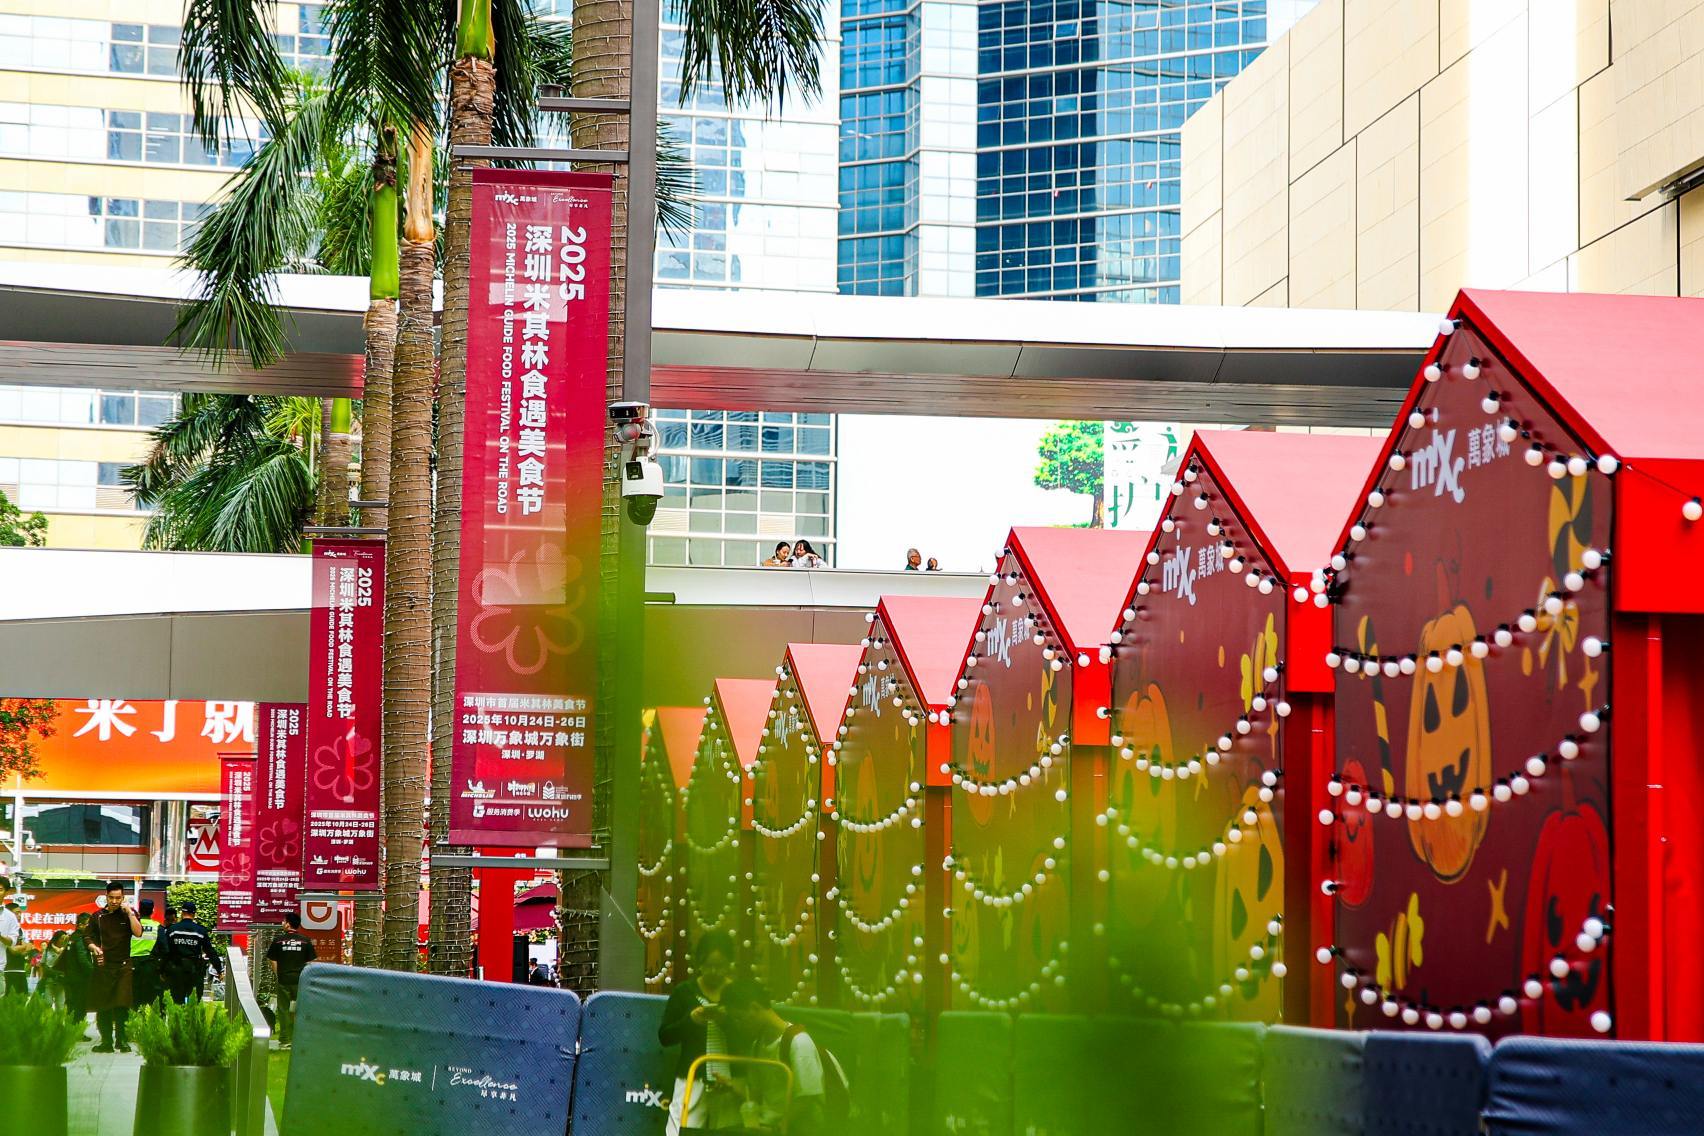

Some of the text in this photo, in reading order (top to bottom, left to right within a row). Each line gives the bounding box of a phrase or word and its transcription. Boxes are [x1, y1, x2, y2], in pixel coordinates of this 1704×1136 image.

[559, 226, 587, 300] 2025
[497, 223, 516, 514] 2025 MICHELIN GUIDE FOOD FESTIVAL ON THE ROAD
[516, 225, 553, 515] 深圳米其林食遇美食节
[358, 567, 373, 607] 2025
[337, 567, 355, 719] 深圳米其林食遇美食节
[327, 677, 333, 687] ON
[463, 696, 586, 711] 深圳市首届米其林美食节
[289, 709, 299, 736] 2025
[462, 714, 586, 728] 2025年10月24日-26日
[462, 730, 585, 747] 深圳万象城万象街
